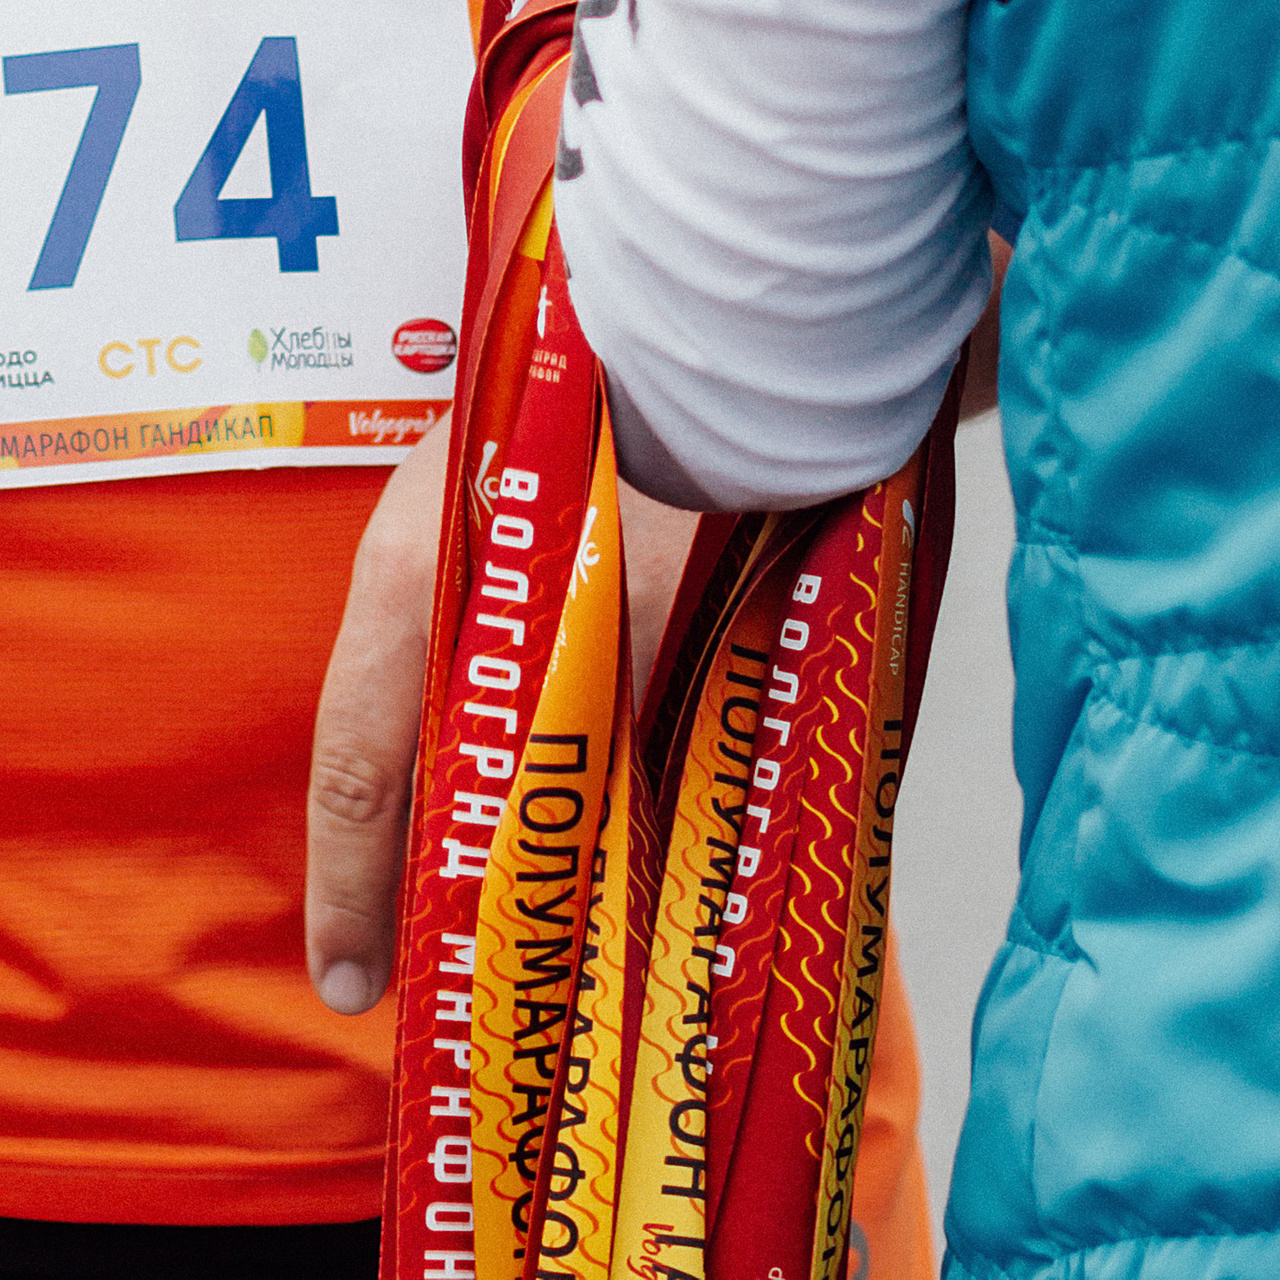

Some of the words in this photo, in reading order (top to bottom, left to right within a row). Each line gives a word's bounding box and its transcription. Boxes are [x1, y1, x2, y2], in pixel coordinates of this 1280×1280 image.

[98, 336, 202, 379] СТС
[139, 414, 274, 448] ГАНДИКАП
[439, 466, 540, 878] ВОЛГОГРАД
[889, 561, 911, 677] HANDICAP
[508, 733, 589, 1280] ПОЛУМАРАФ
[661, 643, 769, 1200] ПОЛУМААФОН
